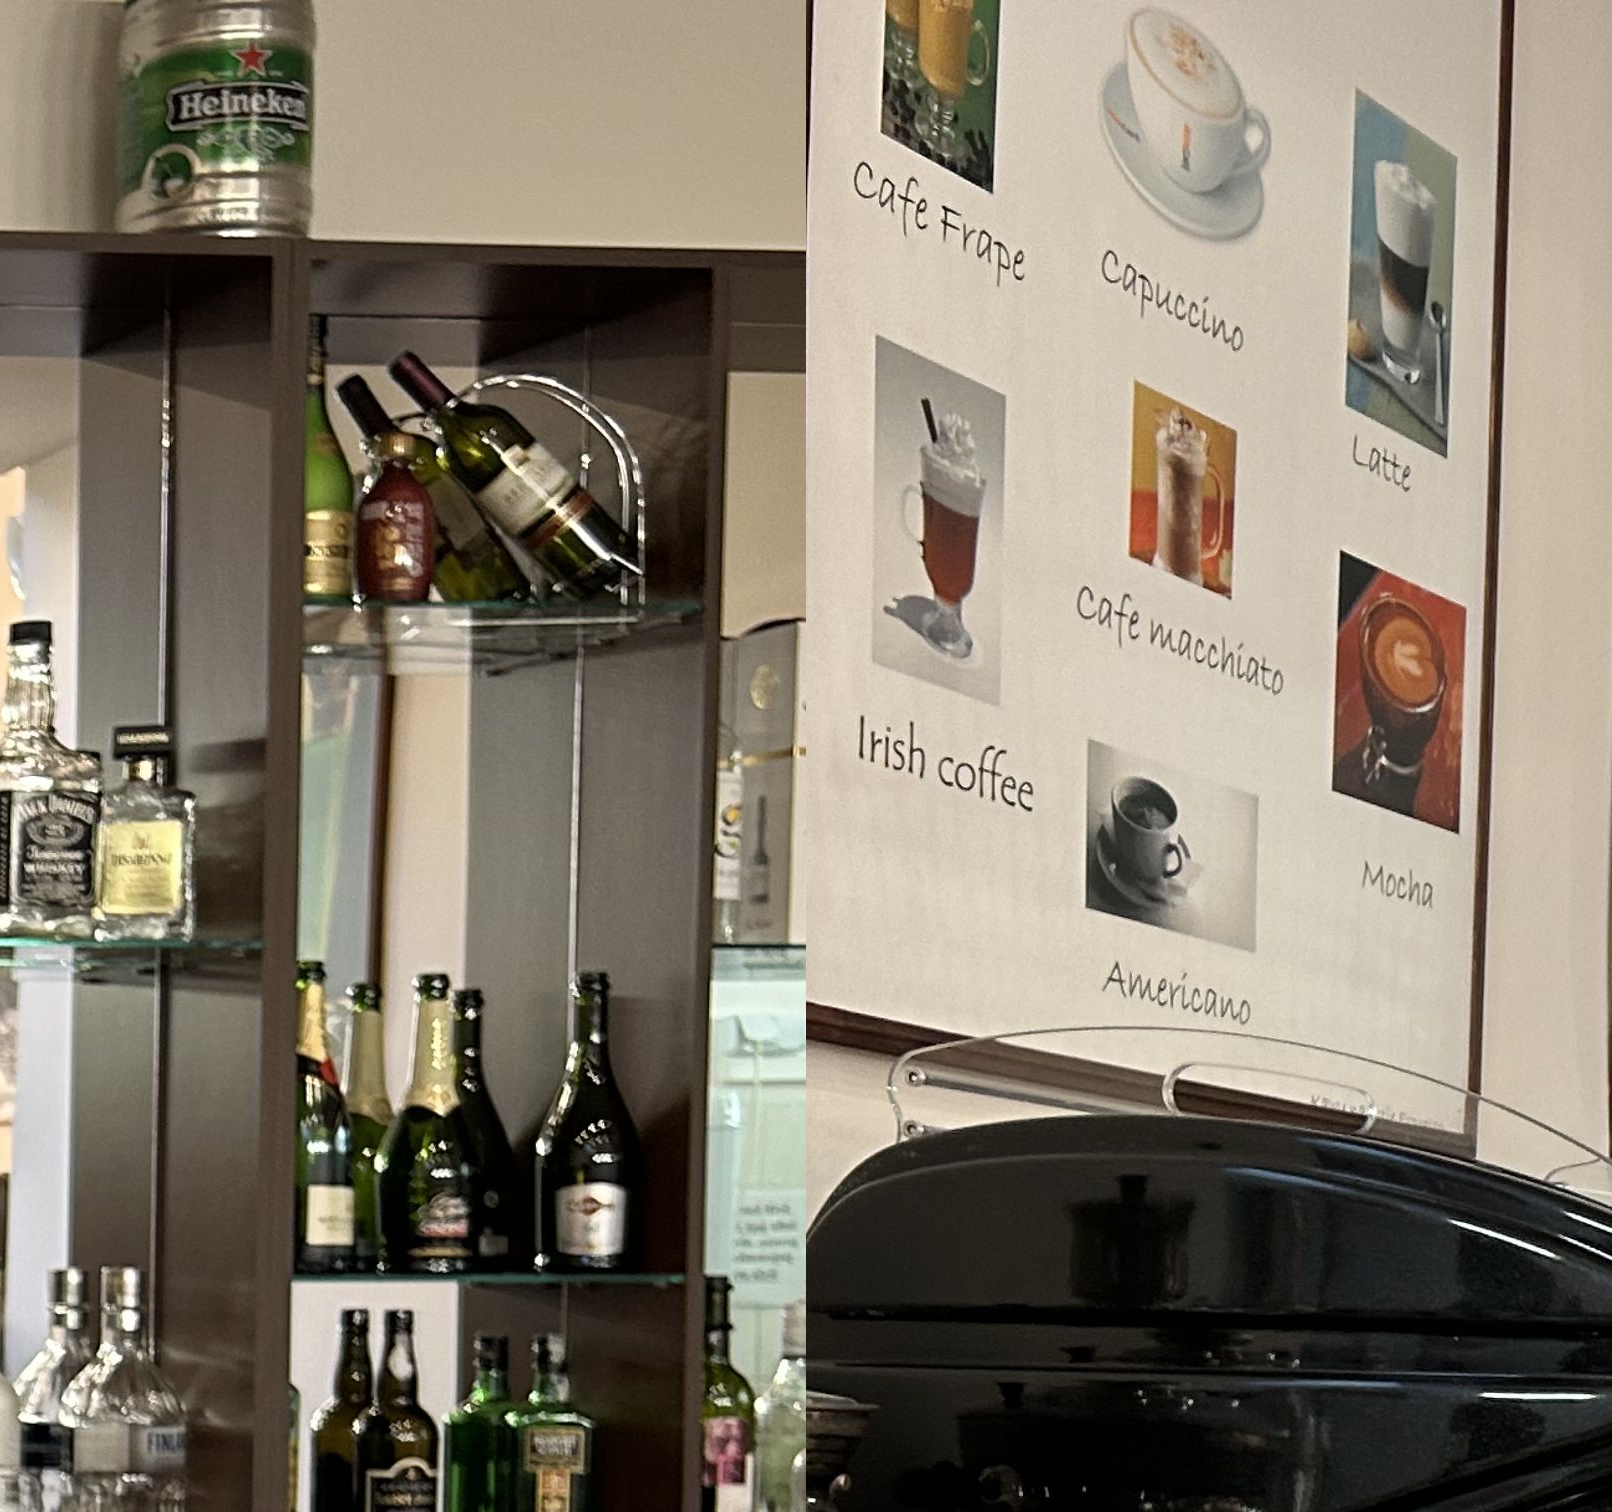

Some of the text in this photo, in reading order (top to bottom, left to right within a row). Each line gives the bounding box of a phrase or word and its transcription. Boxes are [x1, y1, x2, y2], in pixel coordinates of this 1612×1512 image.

[179, 88, 306, 120] Heineken
[853, 161, 1026, 286] Cafe Frape
[1102, 250, 1244, 352] Capuccino
[1352, 435, 1412, 492] Latte
[1076, 585, 1284, 695] Cafe macchiato
[858, 715, 1034, 813] Irish coffee
[1361, 860, 1434, 910] Mocha
[1103, 961, 1252, 1025] Americano
